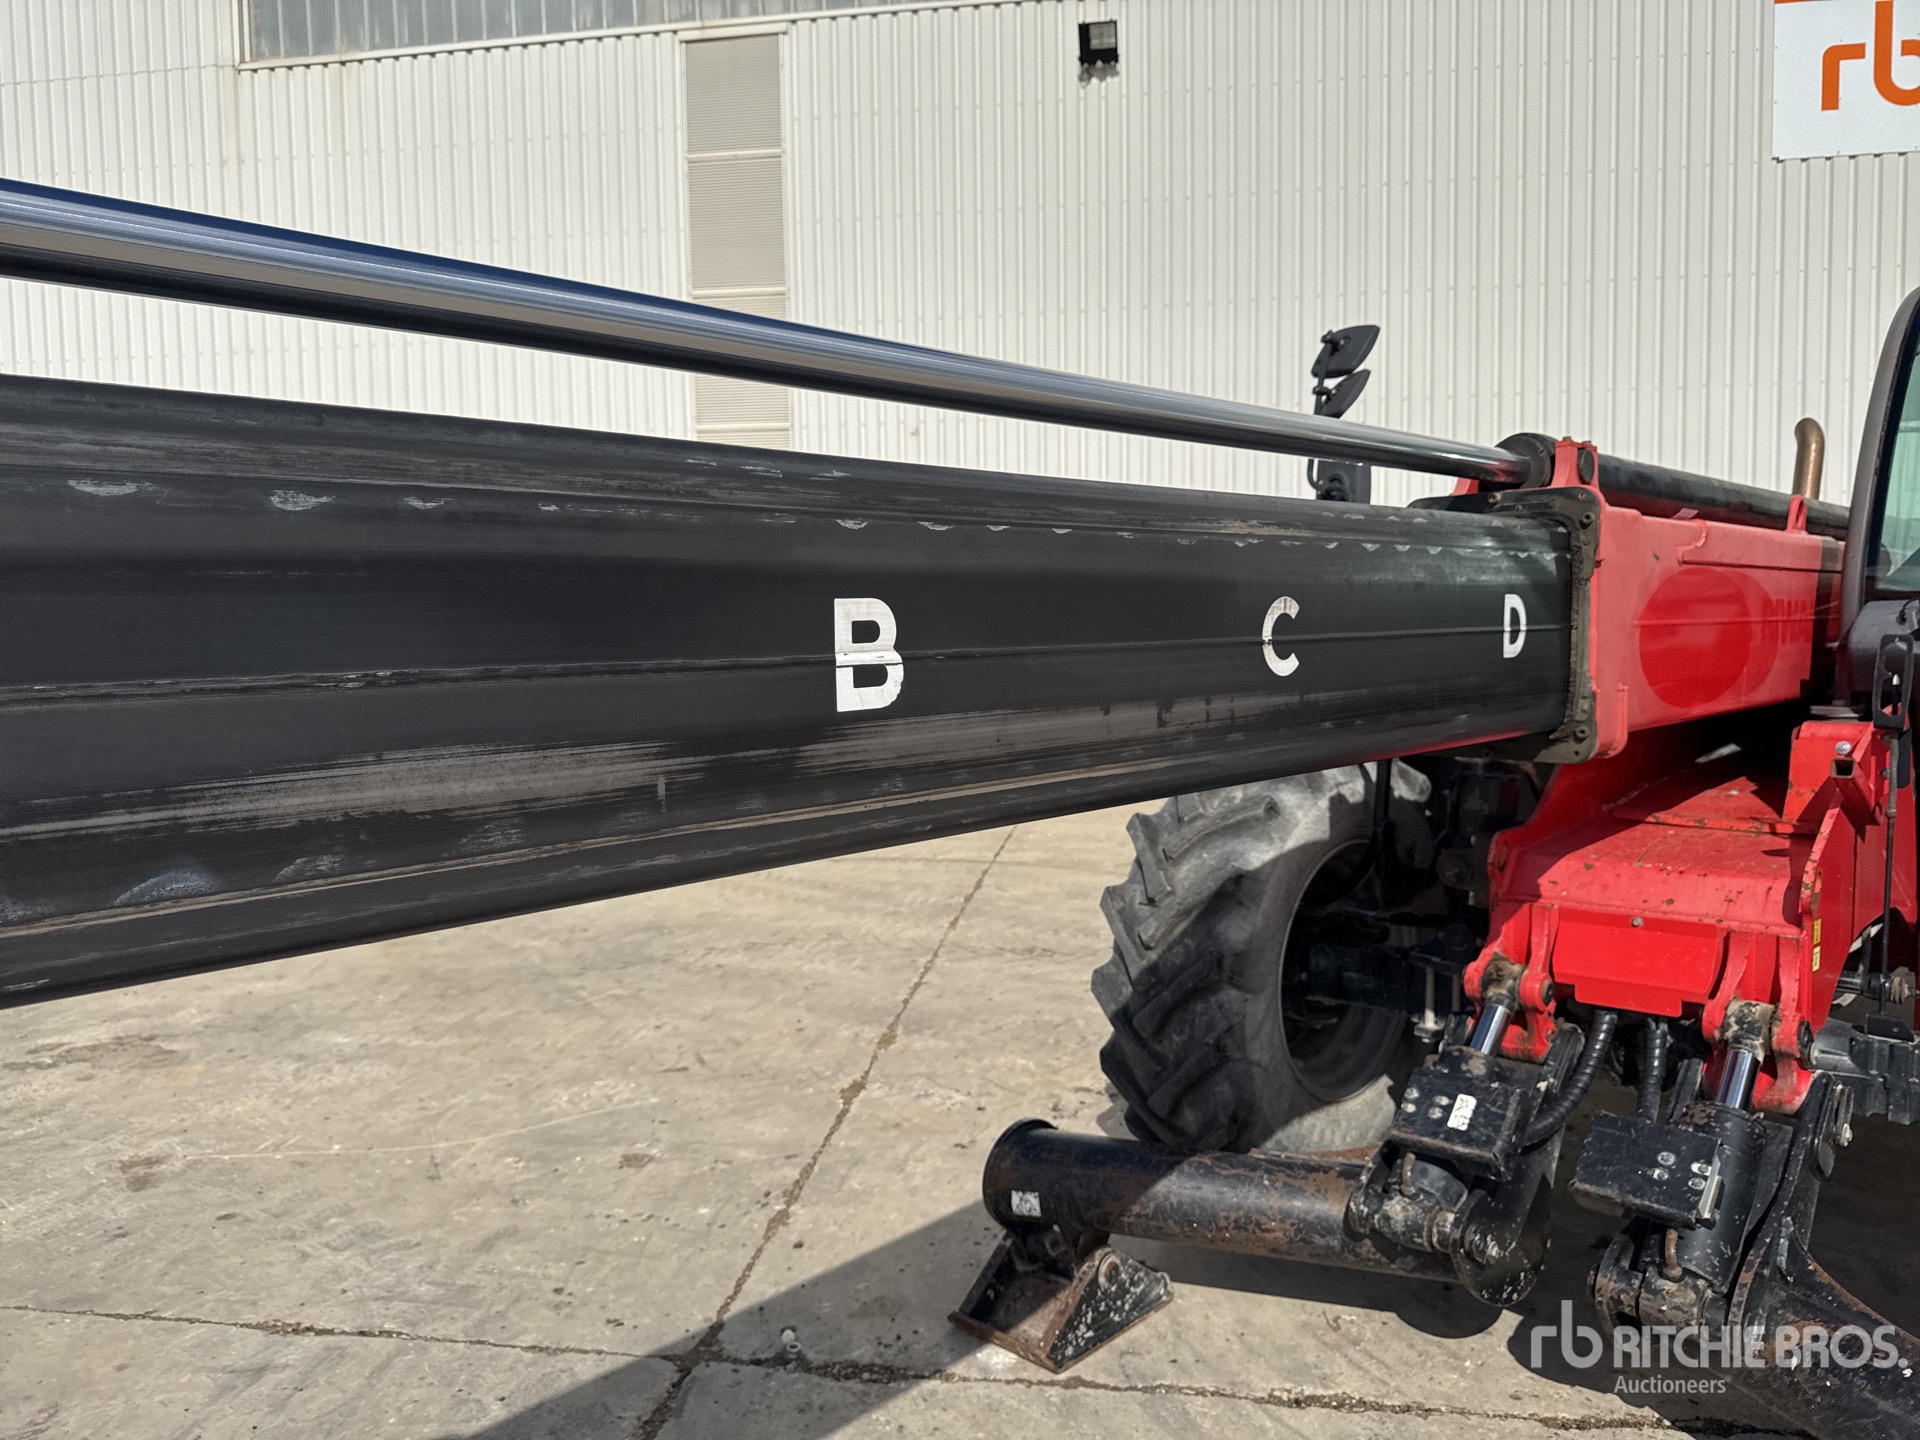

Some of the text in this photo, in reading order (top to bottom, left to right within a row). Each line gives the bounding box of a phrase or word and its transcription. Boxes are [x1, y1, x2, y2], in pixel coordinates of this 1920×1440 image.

[833, 597, 905, 713] B
[1261, 595, 1301, 677] C
[1502, 593, 1527, 659] D
